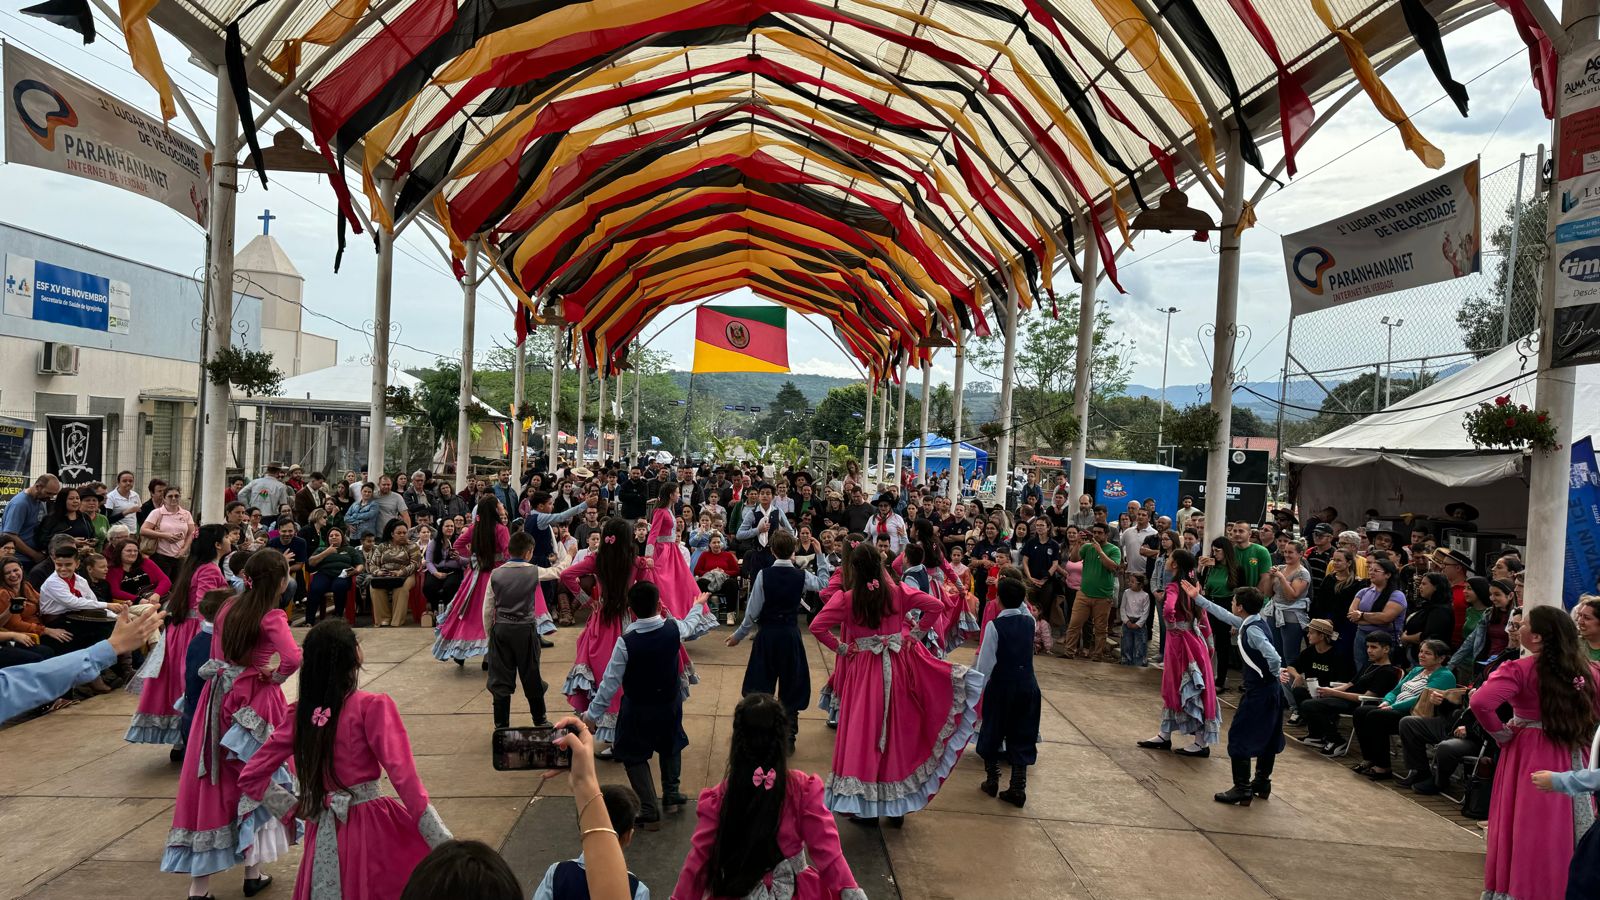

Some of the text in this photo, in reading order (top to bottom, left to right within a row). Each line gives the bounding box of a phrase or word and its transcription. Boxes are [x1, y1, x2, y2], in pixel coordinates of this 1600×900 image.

[1564, 79, 1587, 94] ALMA
[112, 105, 145, 129] LUGAR
[148, 124, 161, 139] NO
[162, 127, 198, 159] RANKING
[64, 133, 169, 190] PARANHANANET
[138, 130, 152, 148] DE
[153, 138, 200, 174] VELOCIDADE
[66, 159, 149, 193] INTERNET DE VERDADE
[1349, 214, 1380, 233] LUGAR
[1380, 207, 1397, 221] NO
[1397, 184, 1452, 217] RANKING
[1375, 225, 1392, 239] DE
[1392, 200, 1457, 234] VELOCIDADE
[1329, 252, 1415, 291] PARANHANANET
[1562, 257, 1600, 276] tim
[36, 280, 49, 291] ESF
[50, 283, 61, 293] XV
[62, 286, 71, 296] DE
[71, 288, 107, 304] NOVEMBRO
[40, 295, 62, 305] Secretaria
[1333, 279, 1394, 302] INTERNET DE VERDADE
[1573, 287, 1597, 297] Desde
[1312, 662, 1329, 671] BOSS
